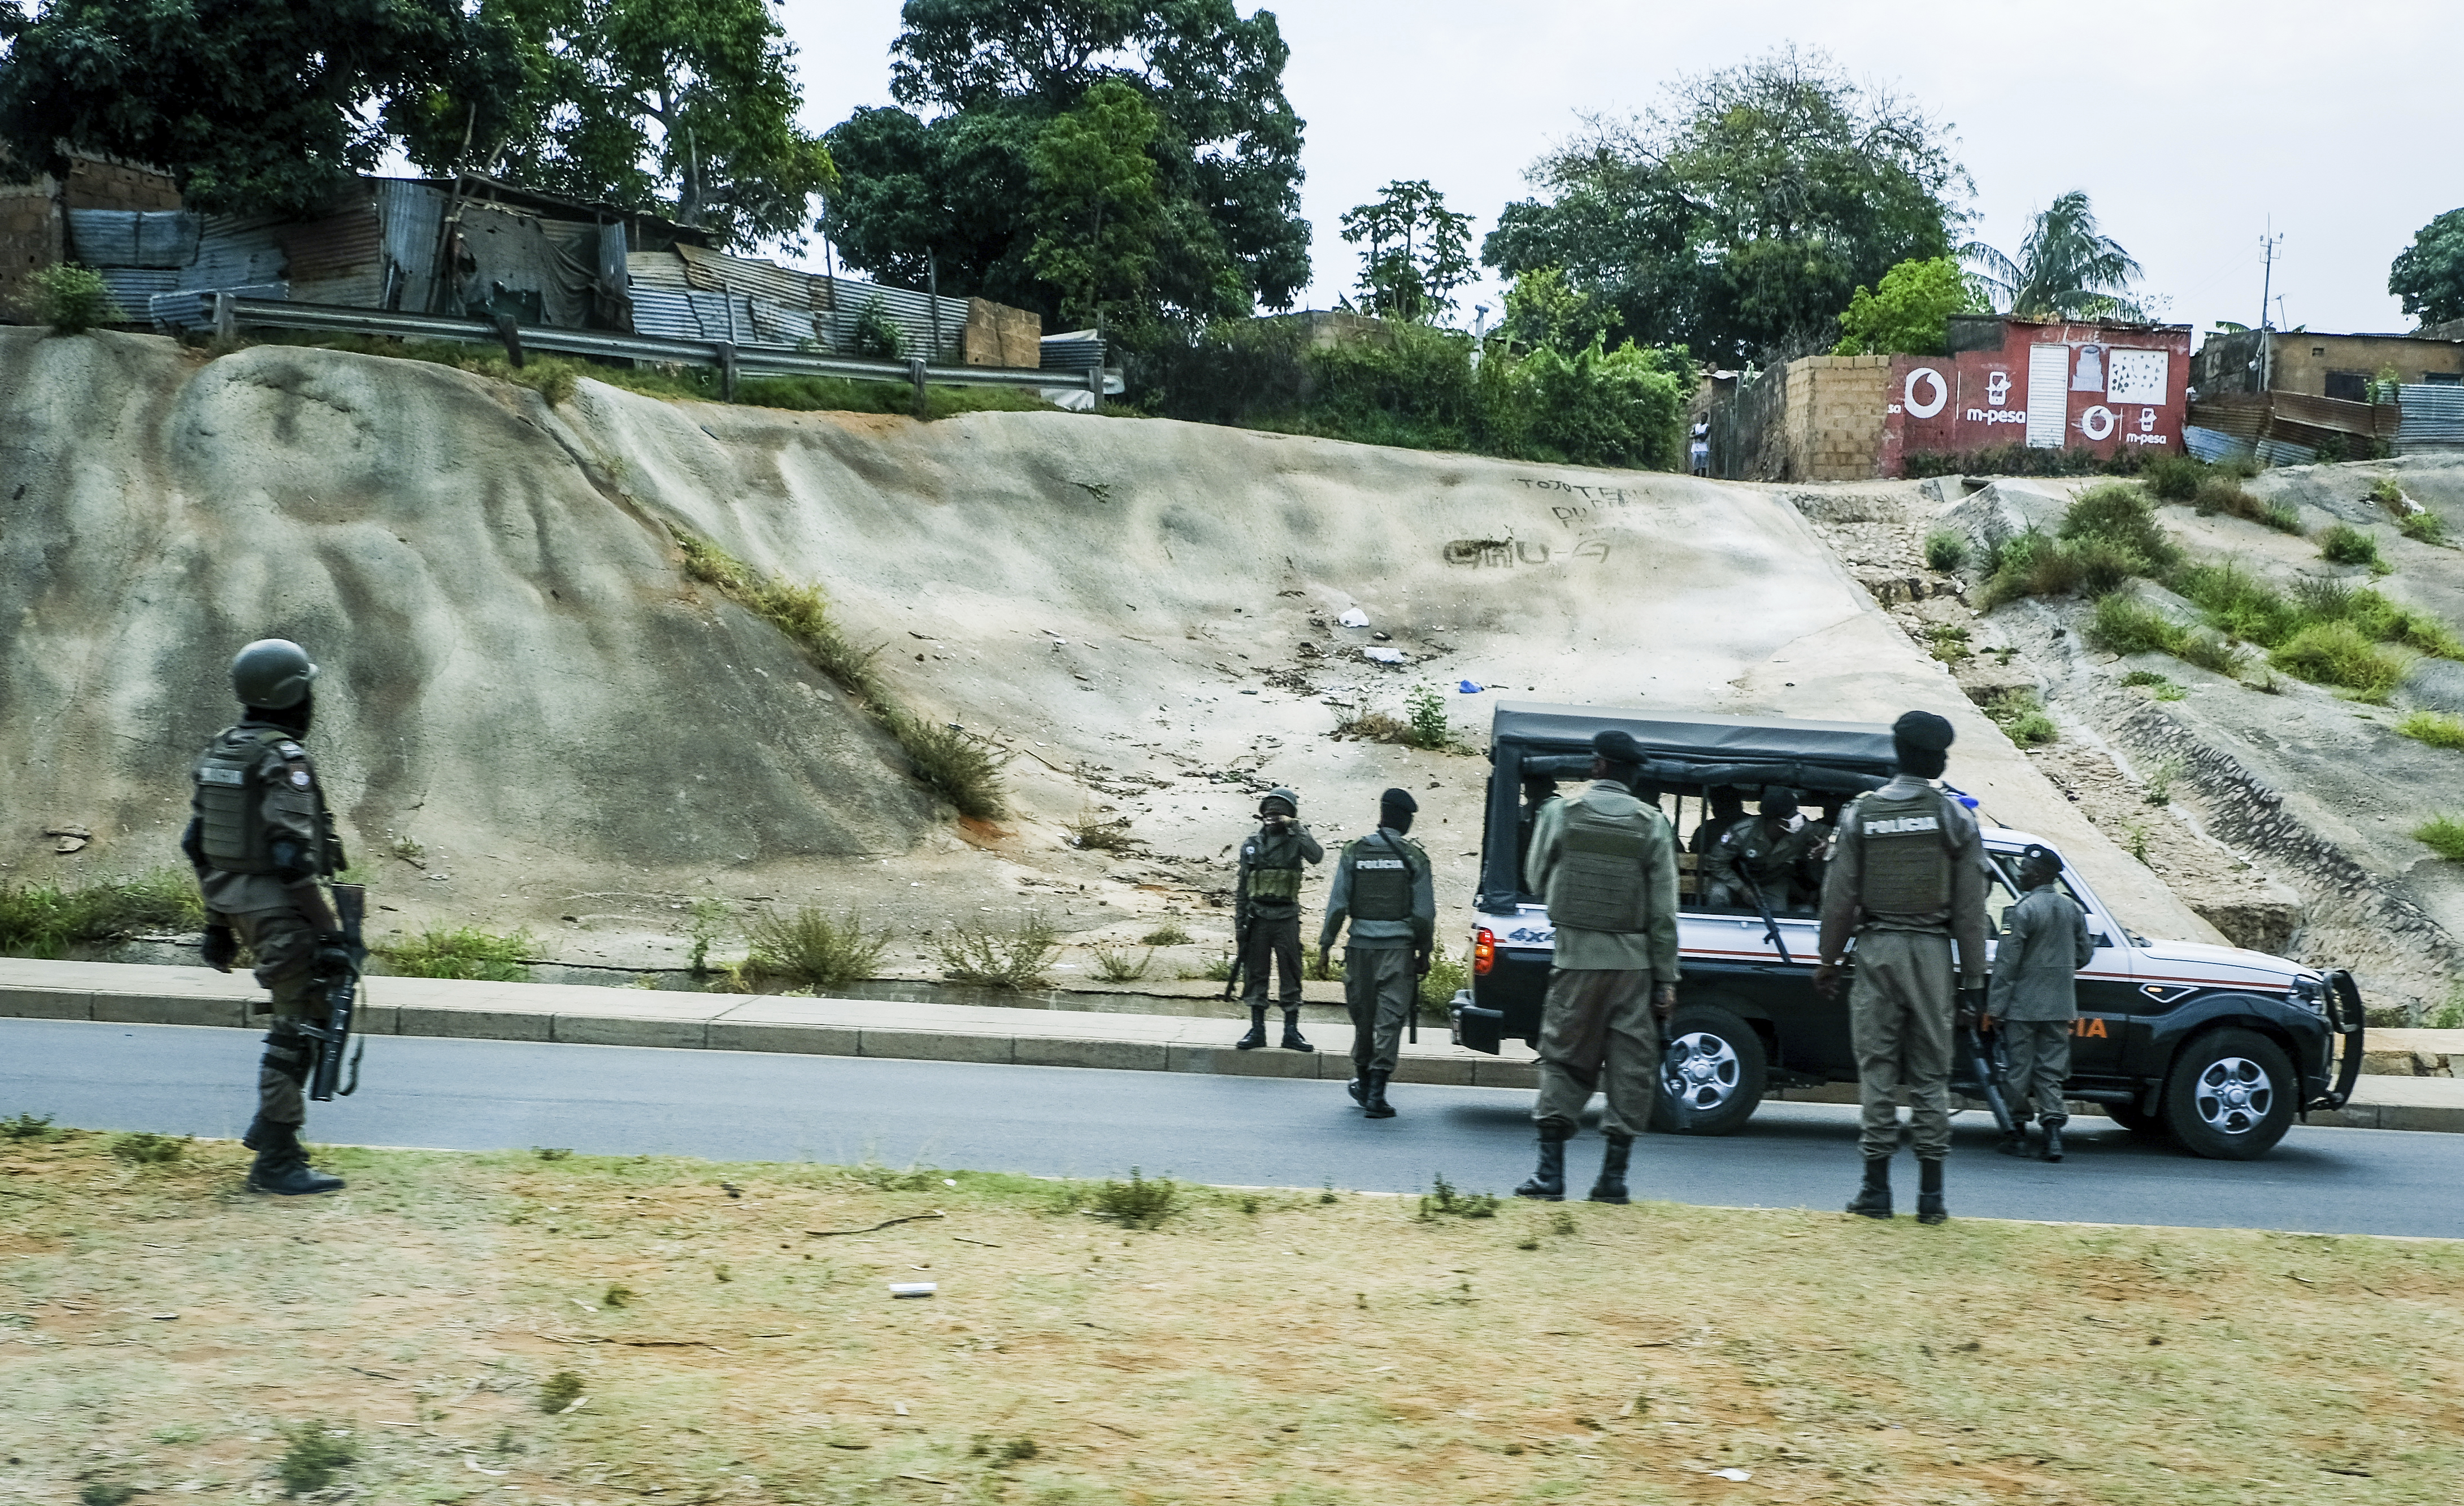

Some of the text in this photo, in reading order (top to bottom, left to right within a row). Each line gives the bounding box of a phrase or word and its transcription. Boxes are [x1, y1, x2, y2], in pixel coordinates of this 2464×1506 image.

[1967, 408, 2026, 426] m-pesa
[2126, 432, 2167, 445] m-pesa
[1863, 817, 1939, 835] POLÍCIA
